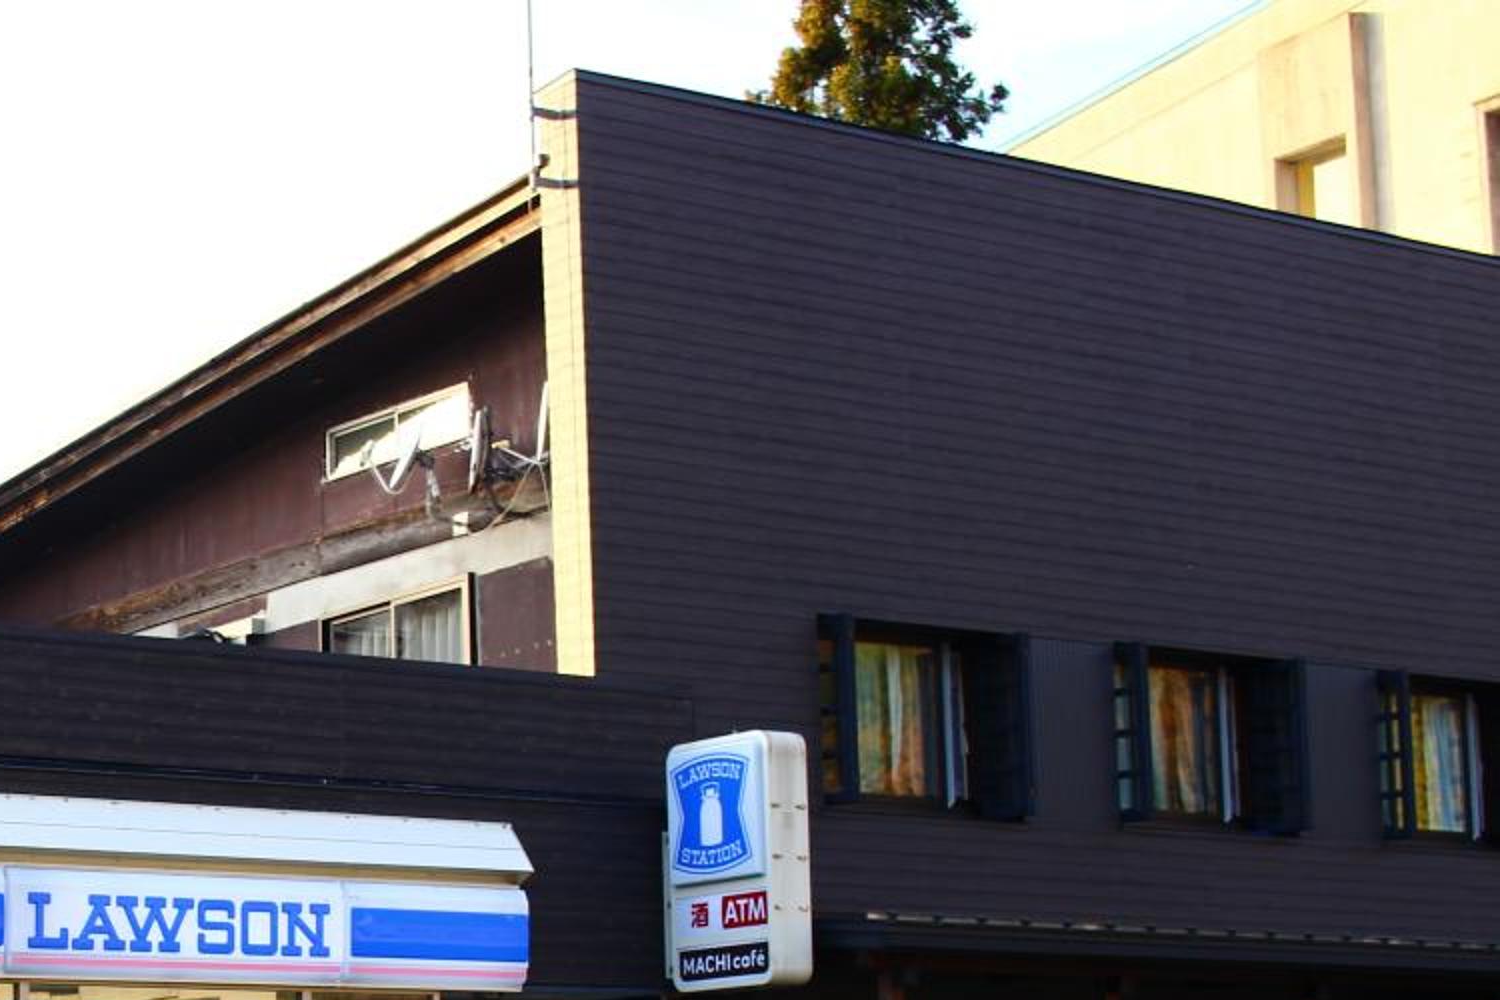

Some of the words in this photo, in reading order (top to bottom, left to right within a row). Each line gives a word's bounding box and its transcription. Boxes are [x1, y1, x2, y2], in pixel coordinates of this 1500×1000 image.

[677, 761, 742, 788] LAWSON
[680, 840, 743, 866] STATION
[27, 892, 331, 957] LAWSON
[691, 902, 709, 928] 酒
[724, 898, 766, 925] ATM
